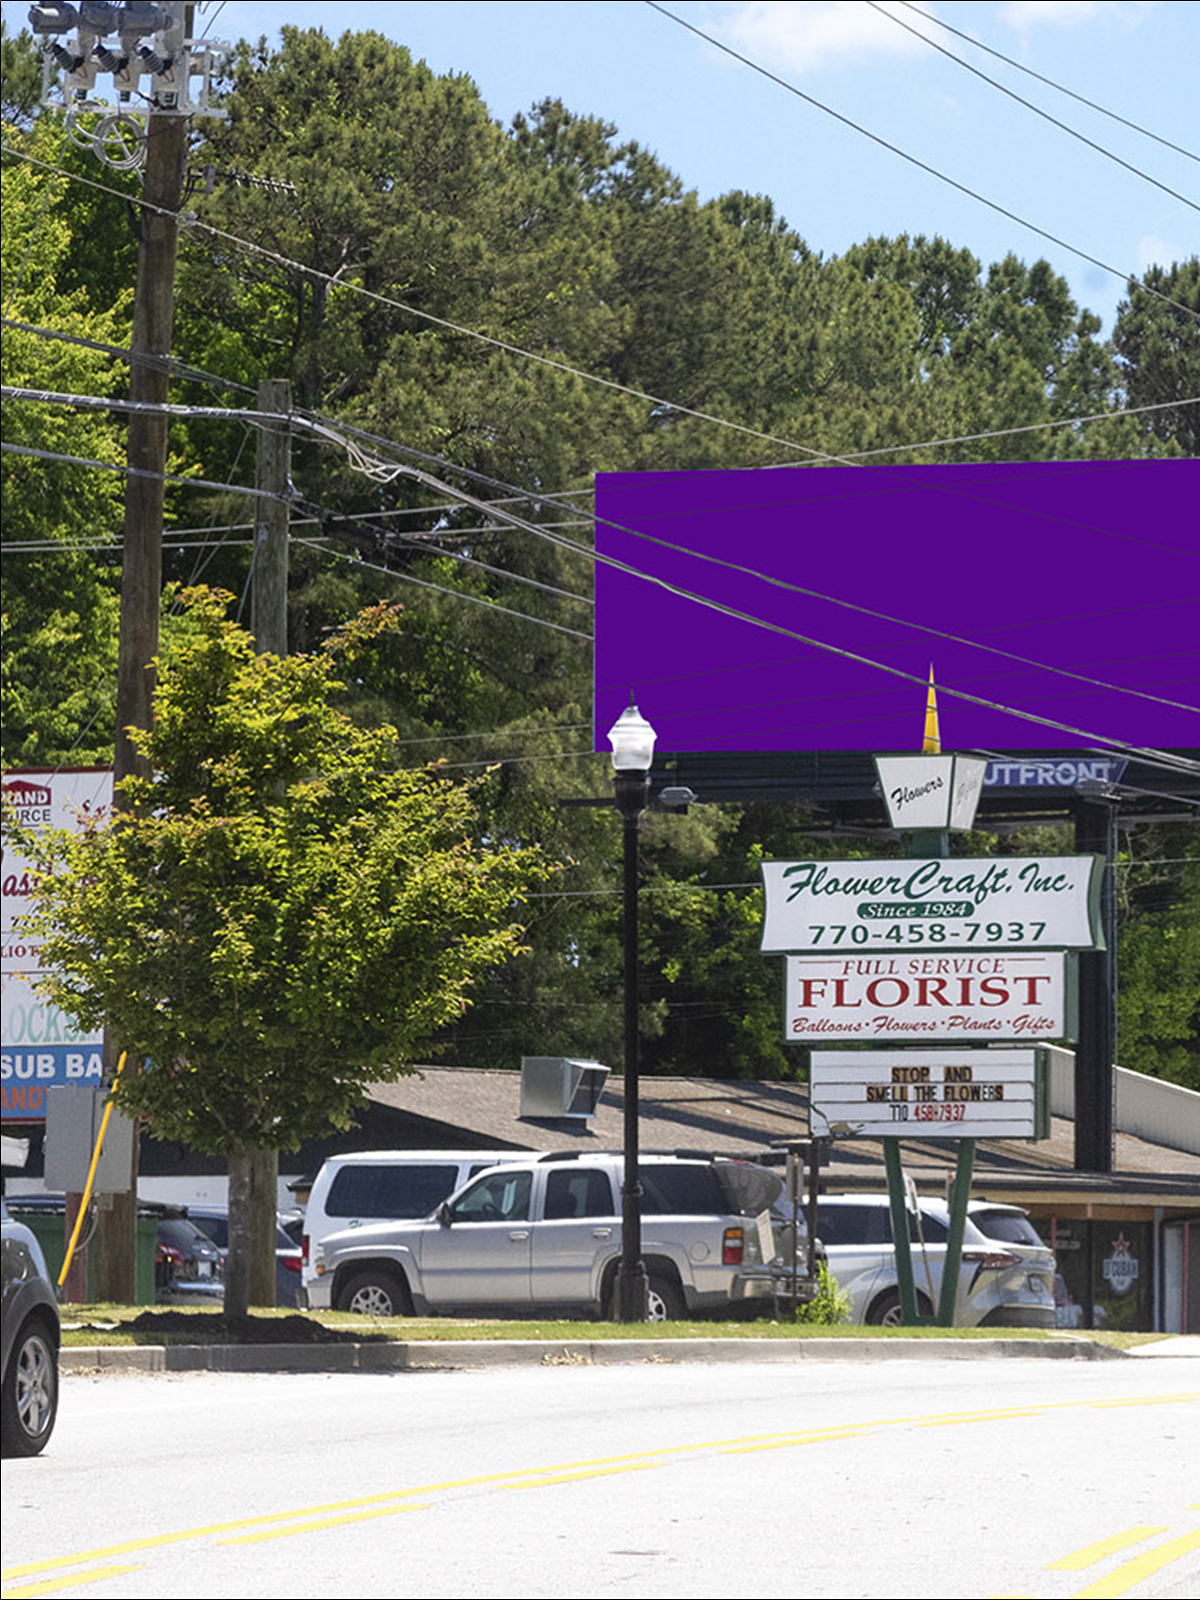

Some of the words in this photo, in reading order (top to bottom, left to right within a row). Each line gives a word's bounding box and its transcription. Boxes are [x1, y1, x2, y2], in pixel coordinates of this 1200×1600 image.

[984, 763, 1111, 785] UTFRONT
[2, 791, 49, 805] AND
[891, 776, 944, 810] Flowers
[1018, 862, 1074, 893] Inc.
[863, 904, 916, 919] Since
[920, 903, 967, 917] 1984
[808, 922, 1047, 944] 770-458-7937
[843, 960, 900, 975] FULL
[908, 958, 1006, 974] SERVICE
[798, 976, 1051, 1008] FLORIST
[792, 1017, 862, 1033] Balloons
[872, 1015, 937, 1033] Flowers
[947, 1014, 1002, 1031] Plants
[1011, 1013, 1055, 1034] Gifts
[892, 1067, 930, 1083] STOP
[944, 1066, 972, 1082] AND
[867, 1086, 908, 1101] SMELL
[914, 1086, 937, 1100] THE
[944, 1085, 1003, 1100] FLOWERS
[889, 1105, 908, 1121] 770
